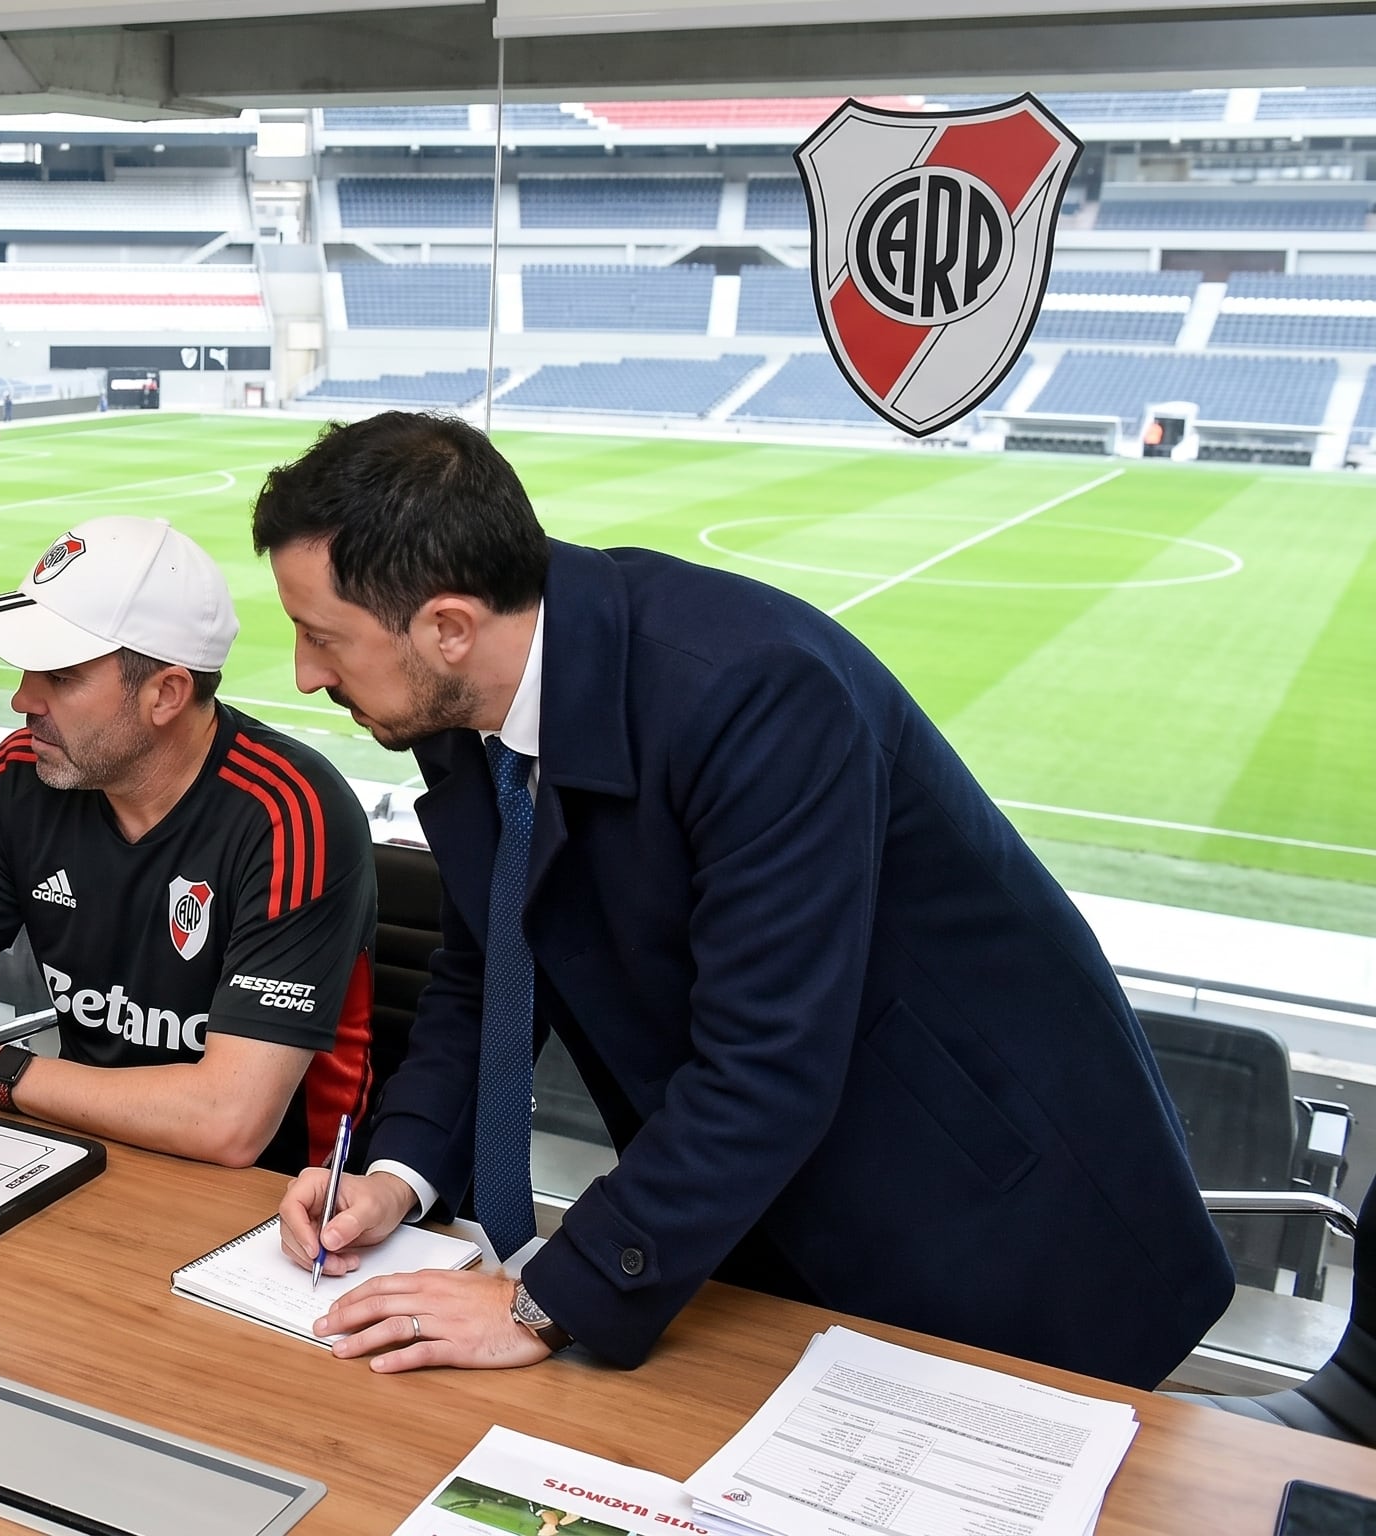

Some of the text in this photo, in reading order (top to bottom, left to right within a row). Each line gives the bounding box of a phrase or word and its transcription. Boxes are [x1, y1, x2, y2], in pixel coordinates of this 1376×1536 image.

[855, 174, 1004, 318] CARP
[32, 889, 77, 908] adidas
[175, 894, 202, 932] CARP
